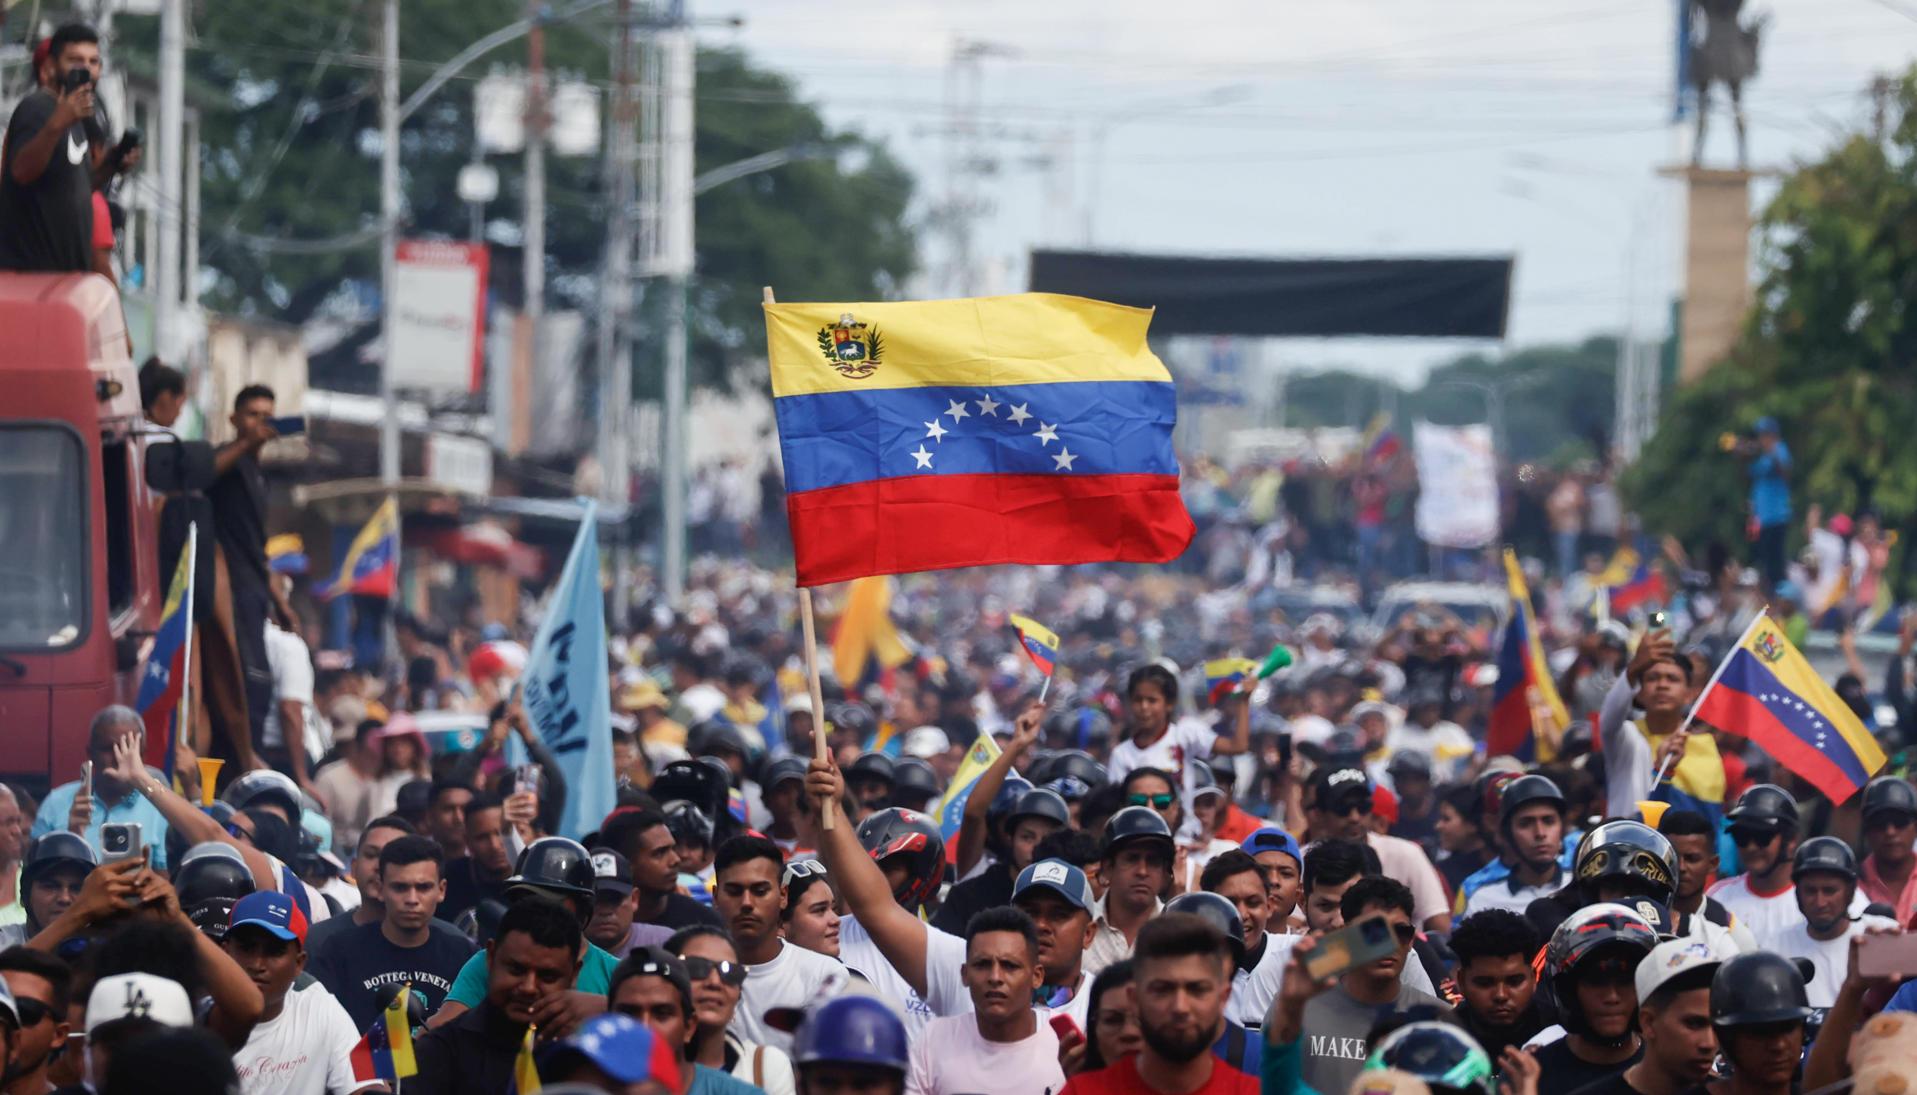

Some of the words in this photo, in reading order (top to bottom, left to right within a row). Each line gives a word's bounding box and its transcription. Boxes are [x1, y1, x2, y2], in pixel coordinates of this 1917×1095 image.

[363, 971, 412, 990] BOTTEGA
[414, 971, 451, 993] VENETA
[123, 981, 152, 1017] LA
[1310, 1035, 1366, 1060] MAKE
